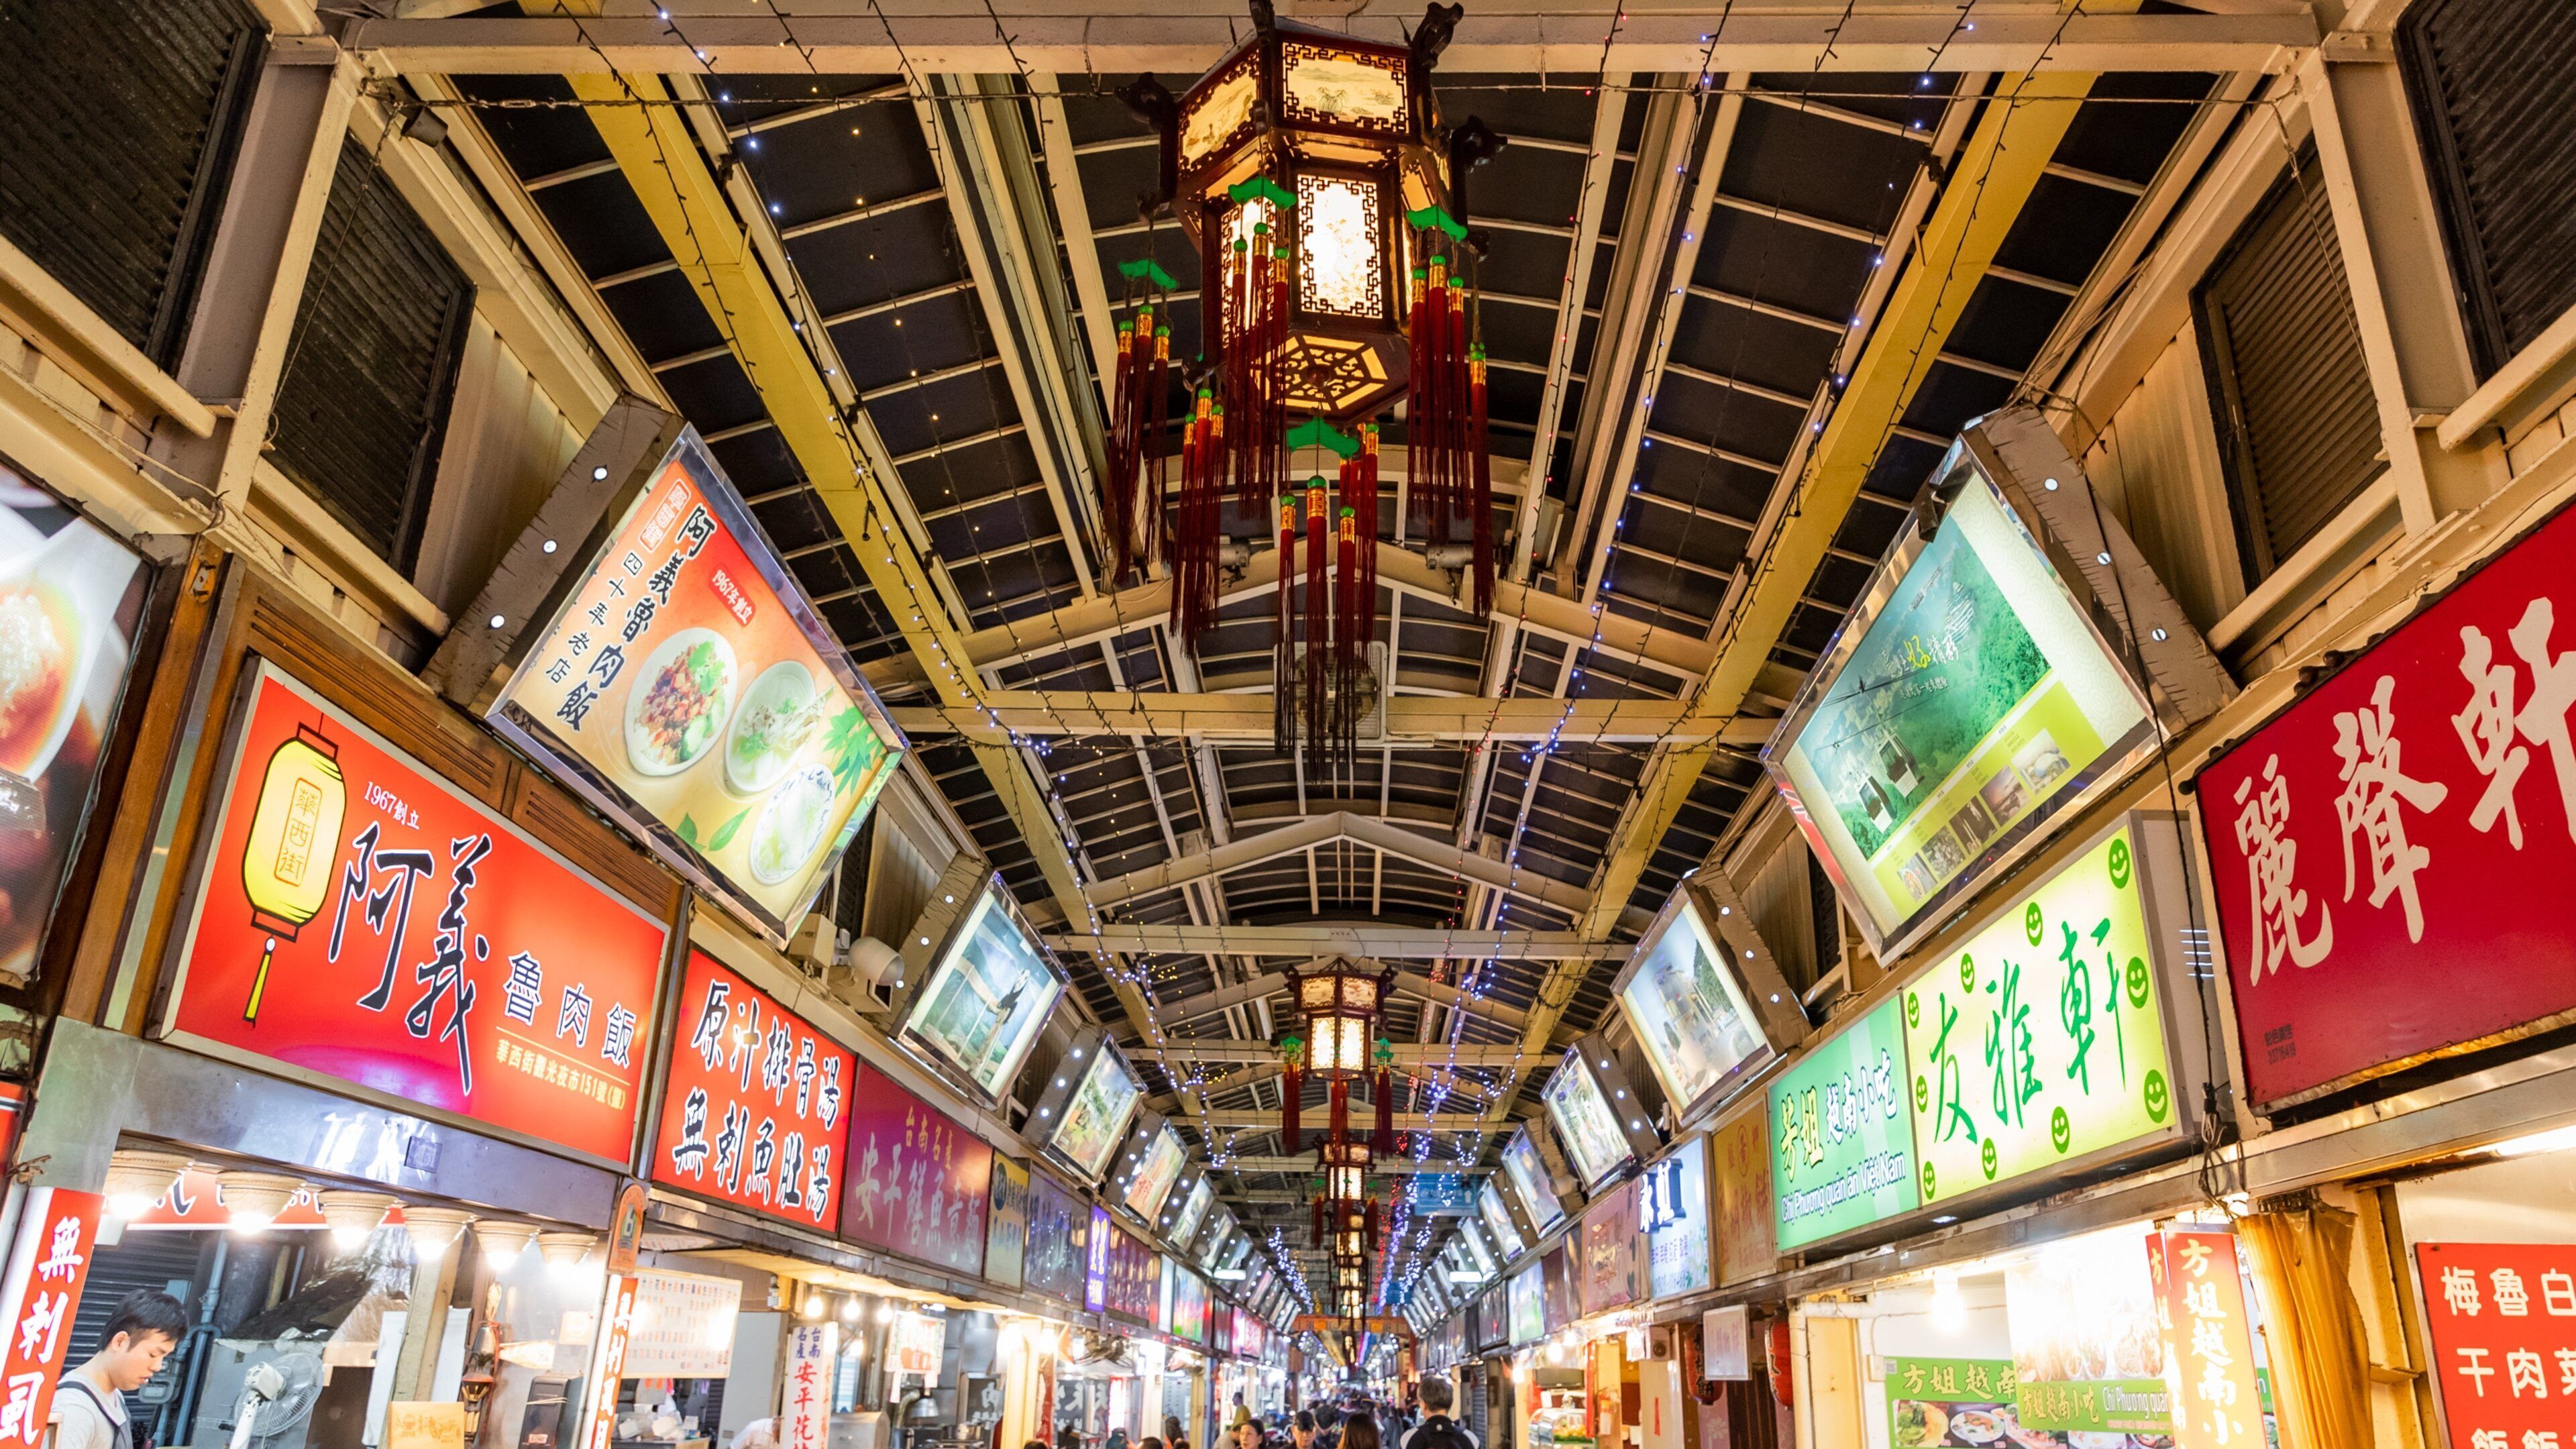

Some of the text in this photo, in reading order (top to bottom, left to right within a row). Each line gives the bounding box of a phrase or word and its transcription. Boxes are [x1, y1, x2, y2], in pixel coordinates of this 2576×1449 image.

[545, 550, 644, 685] 四十年老店
[554, 503, 717, 732] 阿義魯肉飯
[712, 570, 753, 624] 1967年創立
[278, 788, 318, 880] 華西街
[364, 782, 420, 830] 1967創立
[2233, 596, 2576, 987] 麗聲軒
[327, 820, 492, 1097] 阿義
[504, 951, 637, 1069] 魯肉飯
[691, 979, 839, 1131] 原汁排骨湯
[1929, 917, 2127, 1144] 友雅軒
[672, 1087, 831, 1222] 無刺魚肚湯
[906, 1106, 953, 1170] 台南名產
[1880, 1150, 1907, 1187] Nam
[796, 1328, 808, 1358] 名產
[809, 1328, 822, 1358] 台南
[2180, 1238, 2243, 1449] 方姐越南小
[792, 1361, 817, 1449] 安平花
[2023, 1385, 2100, 1425] 方姐越南小吃
